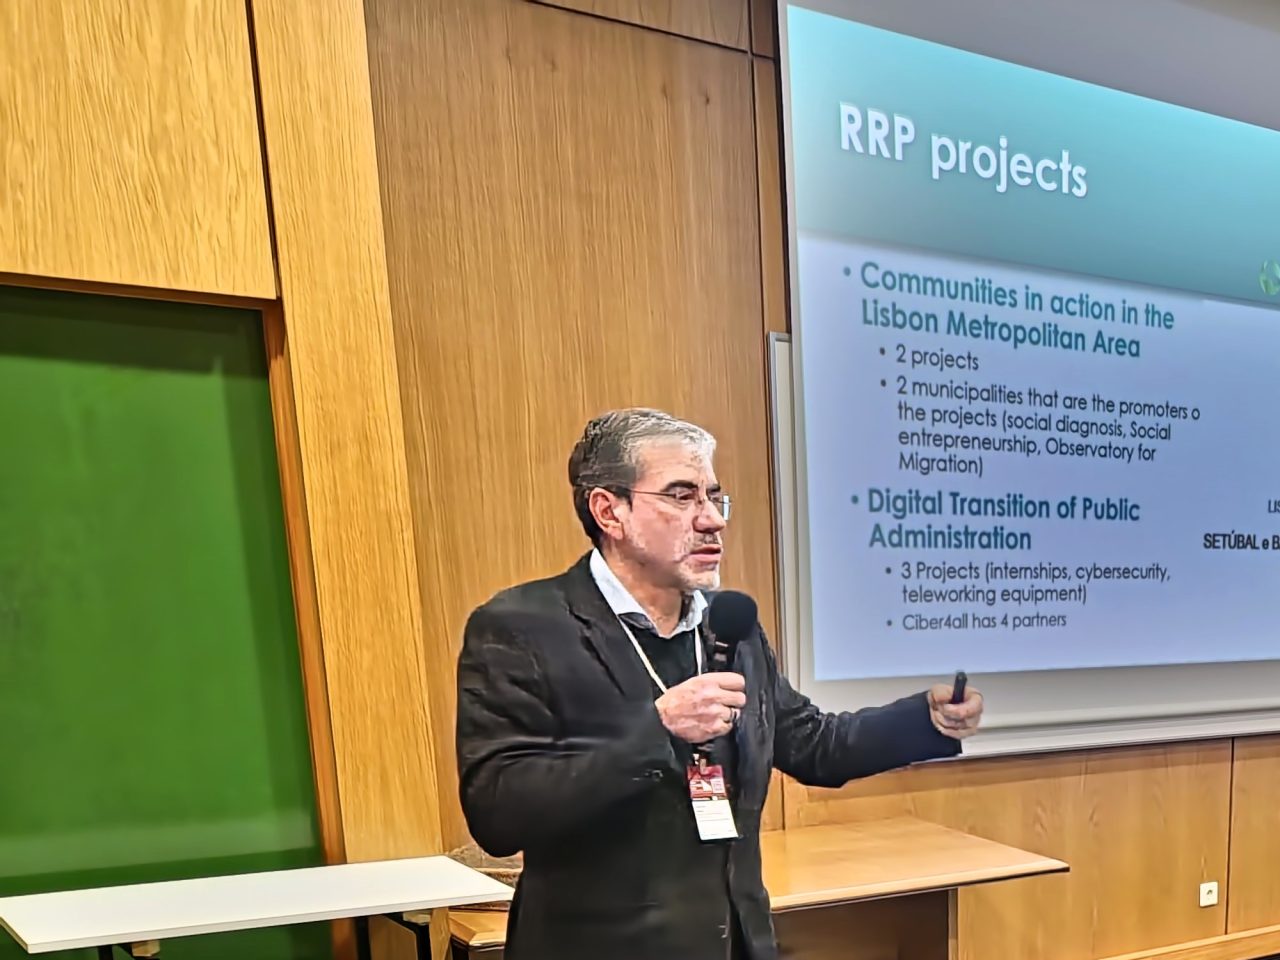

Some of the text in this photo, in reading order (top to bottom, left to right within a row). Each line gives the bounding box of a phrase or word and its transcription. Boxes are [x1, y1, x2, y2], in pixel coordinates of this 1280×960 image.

[839, 101, 1088, 198] RRP projects
[860, 261, 1175, 330] Communities in action in the
[861, 298, 1141, 358] Lisbon Metropolitan Area
[896, 344, 980, 371] 2 projects
[896, 375, 907, 394] 2
[912, 379, 1024, 405] municipalities
[1028, 387, 1059, 409] that
[1062, 394, 1088, 411] are
[1092, 393, 1115, 413] the
[1119, 399, 1189, 420] promoters
[898, 400, 1171, 441] the projects (social diagnosis, Social
[898, 430, 1157, 464] entrepreneurship, Observatory for
[898, 452, 984, 478] Migration)
[867, 488, 1141, 521] Digital Transition of Public
[868, 523, 1032, 550] Administration
[1203, 530, 1260, 551] SETÚBAL
[1261, 539, 1270, 550] e
[901, 561, 1170, 584] 3 Projects (internships, cybersecurity,
[902, 584, 1087, 606] teleworking equipment)
[902, 613, 1067, 632] Ciber4all has 4 partners
